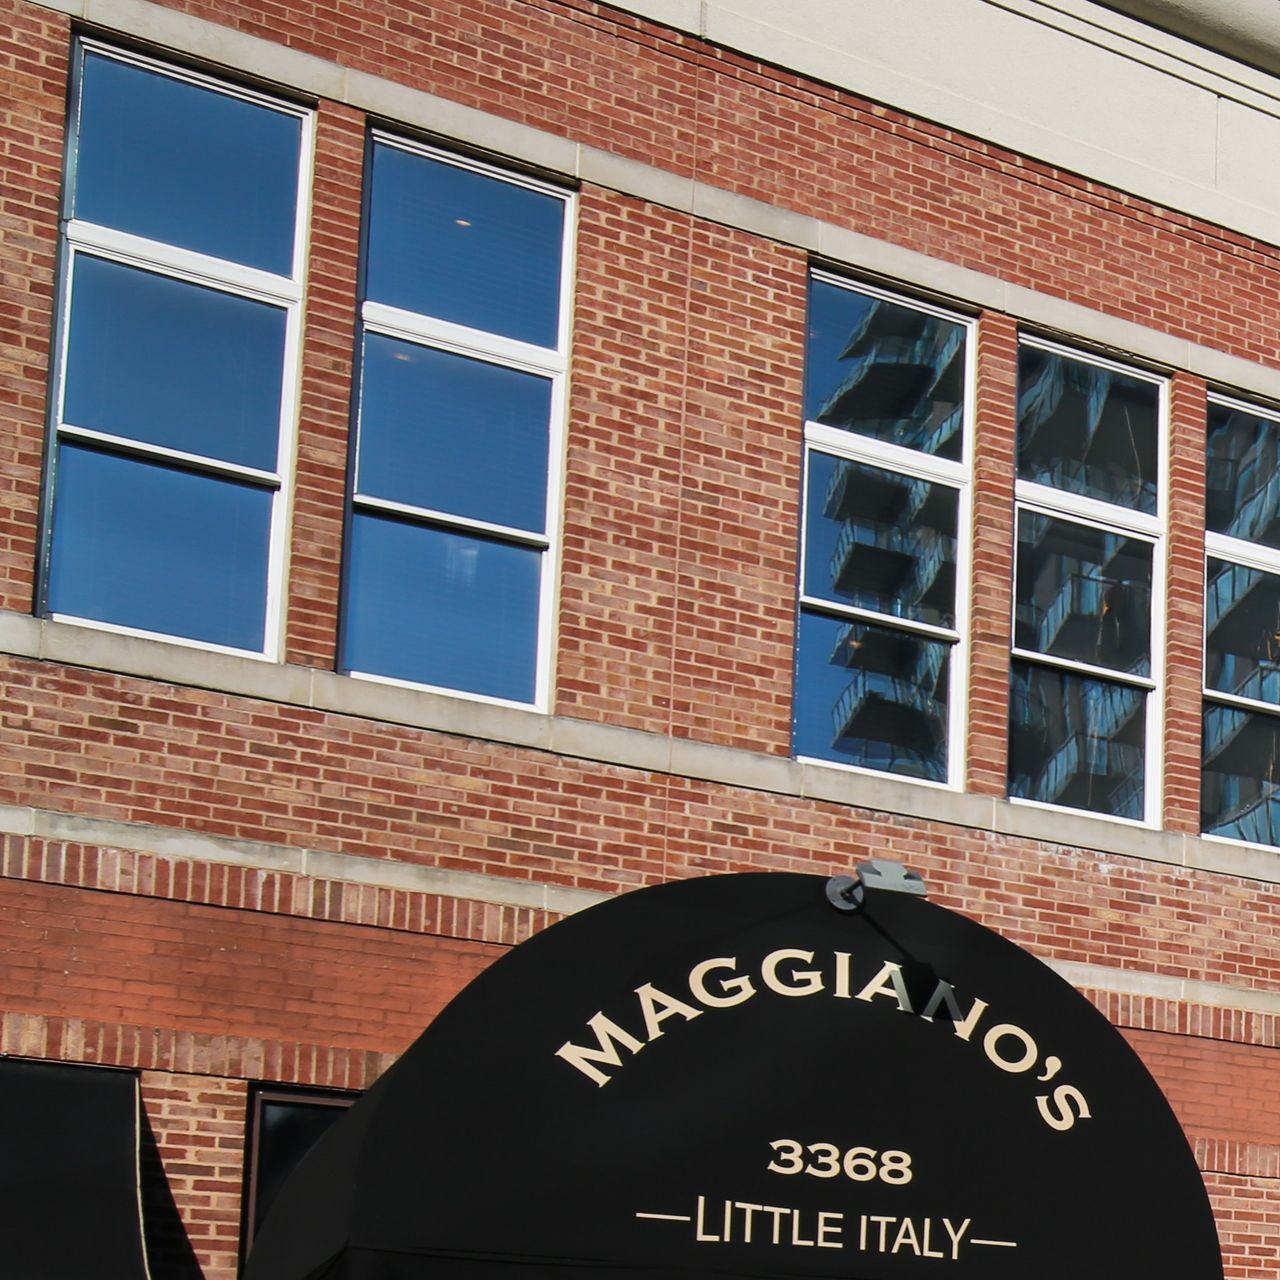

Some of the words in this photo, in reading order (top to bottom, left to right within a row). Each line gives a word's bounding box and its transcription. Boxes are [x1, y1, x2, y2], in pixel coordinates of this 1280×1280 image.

[555, 948, 1092, 1131] MAGGIANO'S
[767, 1139, 913, 1185] 3368
[696, 1195, 844, 1249] LITTLE
[859, 1214, 971, 1260] ITALY
